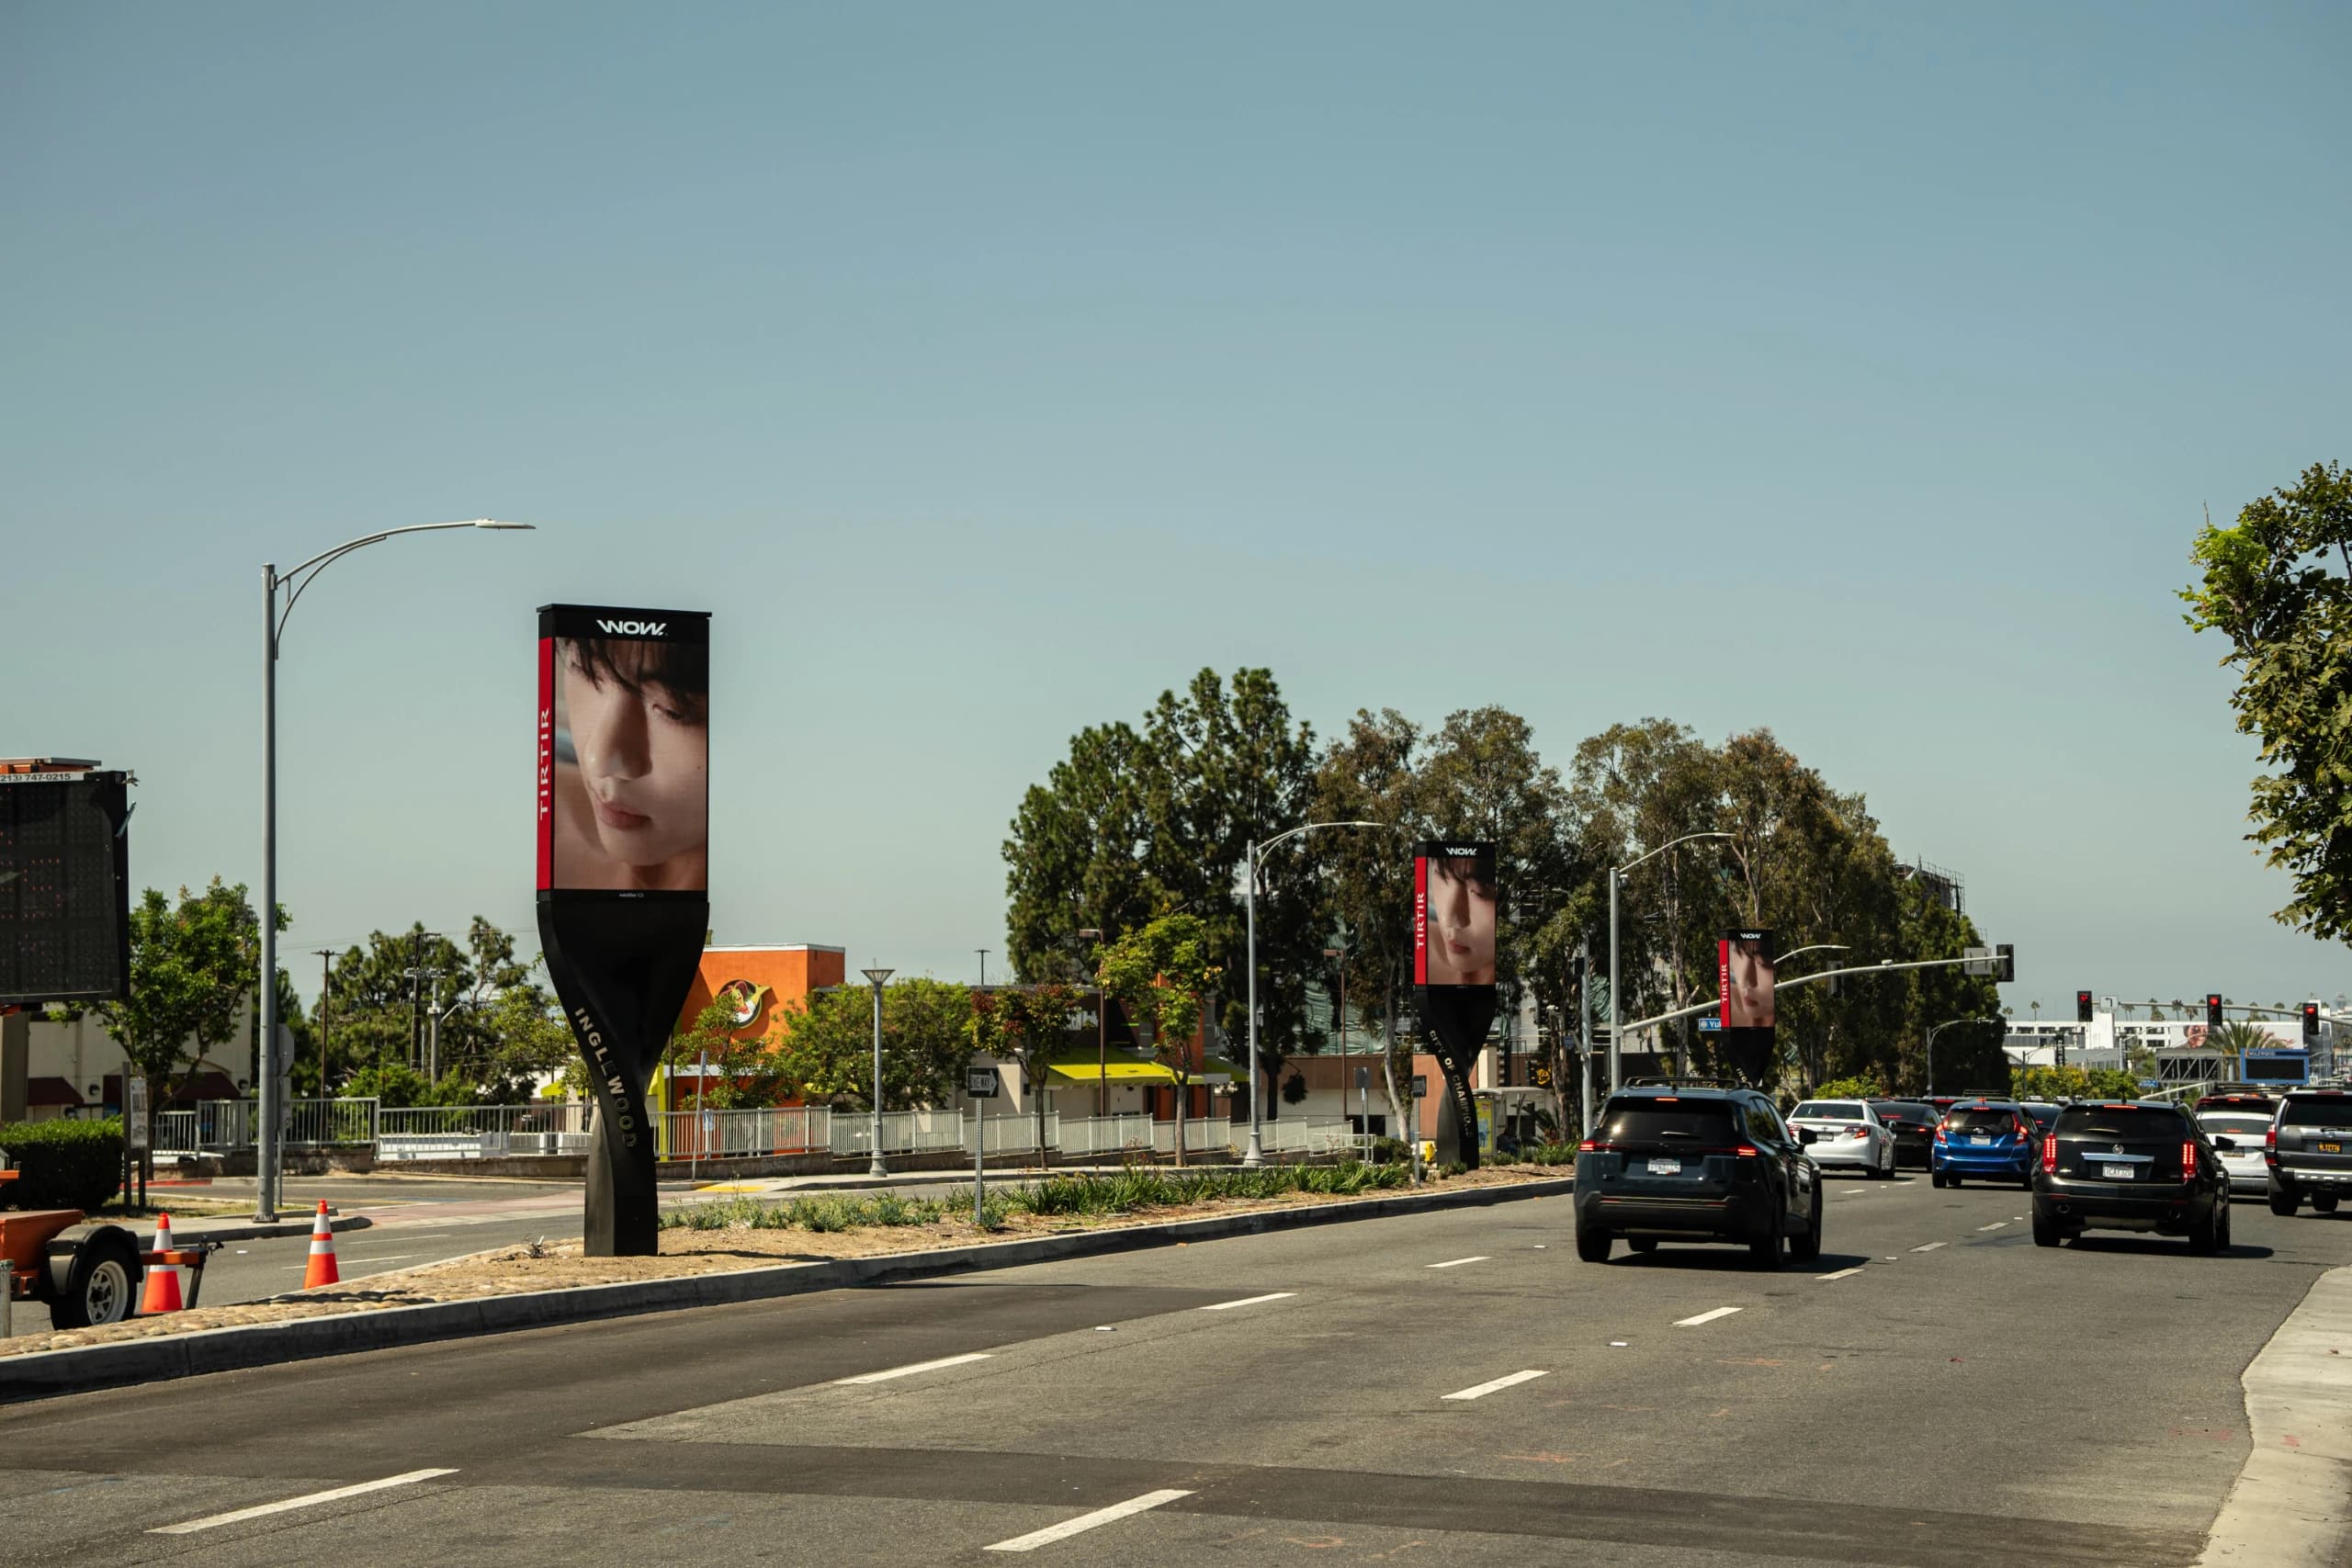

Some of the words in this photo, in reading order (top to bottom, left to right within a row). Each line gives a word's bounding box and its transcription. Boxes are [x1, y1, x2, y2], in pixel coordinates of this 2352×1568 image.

[539, 707, 549, 820] TIRTIR
[1417, 892, 1425, 950] TIRTIR
[574, 1008, 638, 1147] INGLEWOOD
[1444, 1057, 1456, 1072] OF
